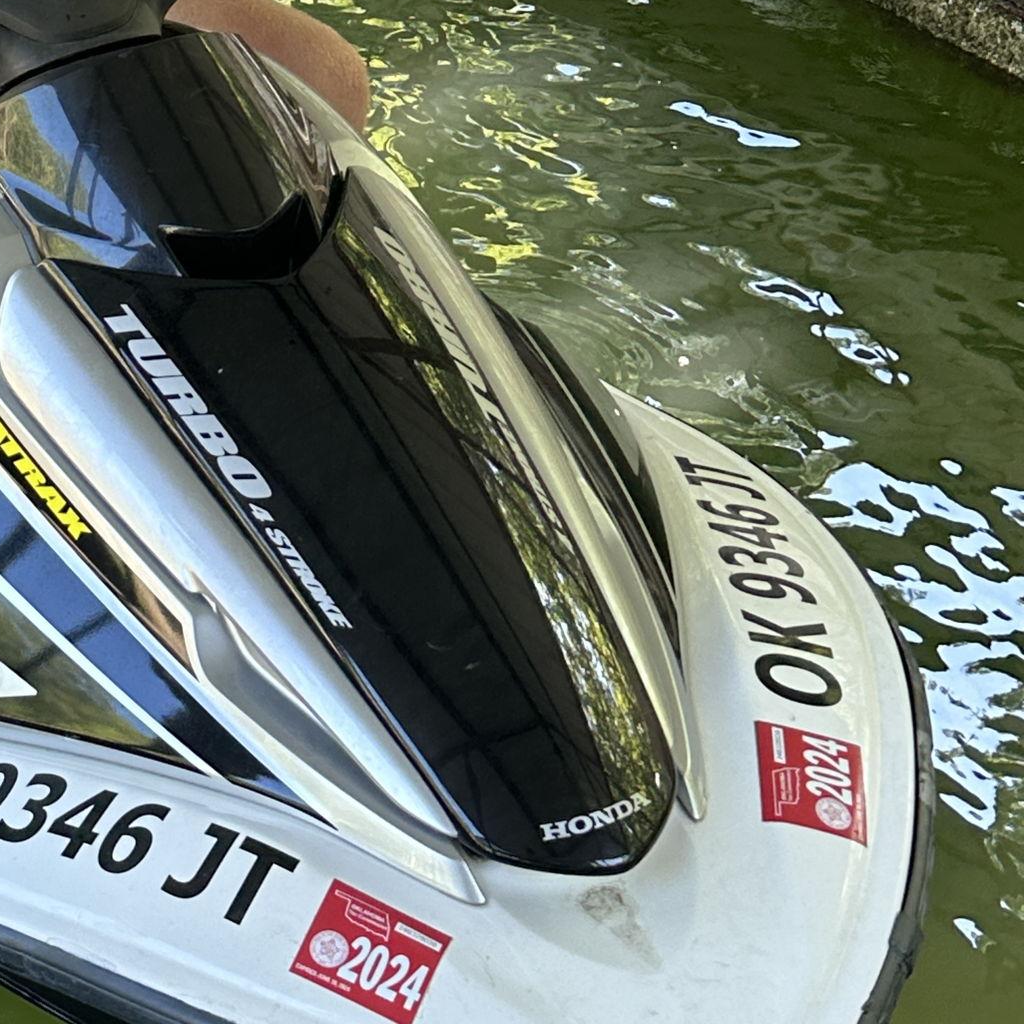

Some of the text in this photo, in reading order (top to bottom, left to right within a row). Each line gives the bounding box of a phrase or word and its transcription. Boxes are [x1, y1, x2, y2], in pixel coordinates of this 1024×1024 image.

[374, 226, 507, 424] TURBO
[104, 304, 352, 628] TURBO 4 STROKE
[674, 455, 842, 707] OK 9346 JT
[540, 793, 651, 841] HONDA
[802, 735, 853, 806] 2024
[161, 823, 300, 926] JT
[336, 936, 429, 1011] 2024
